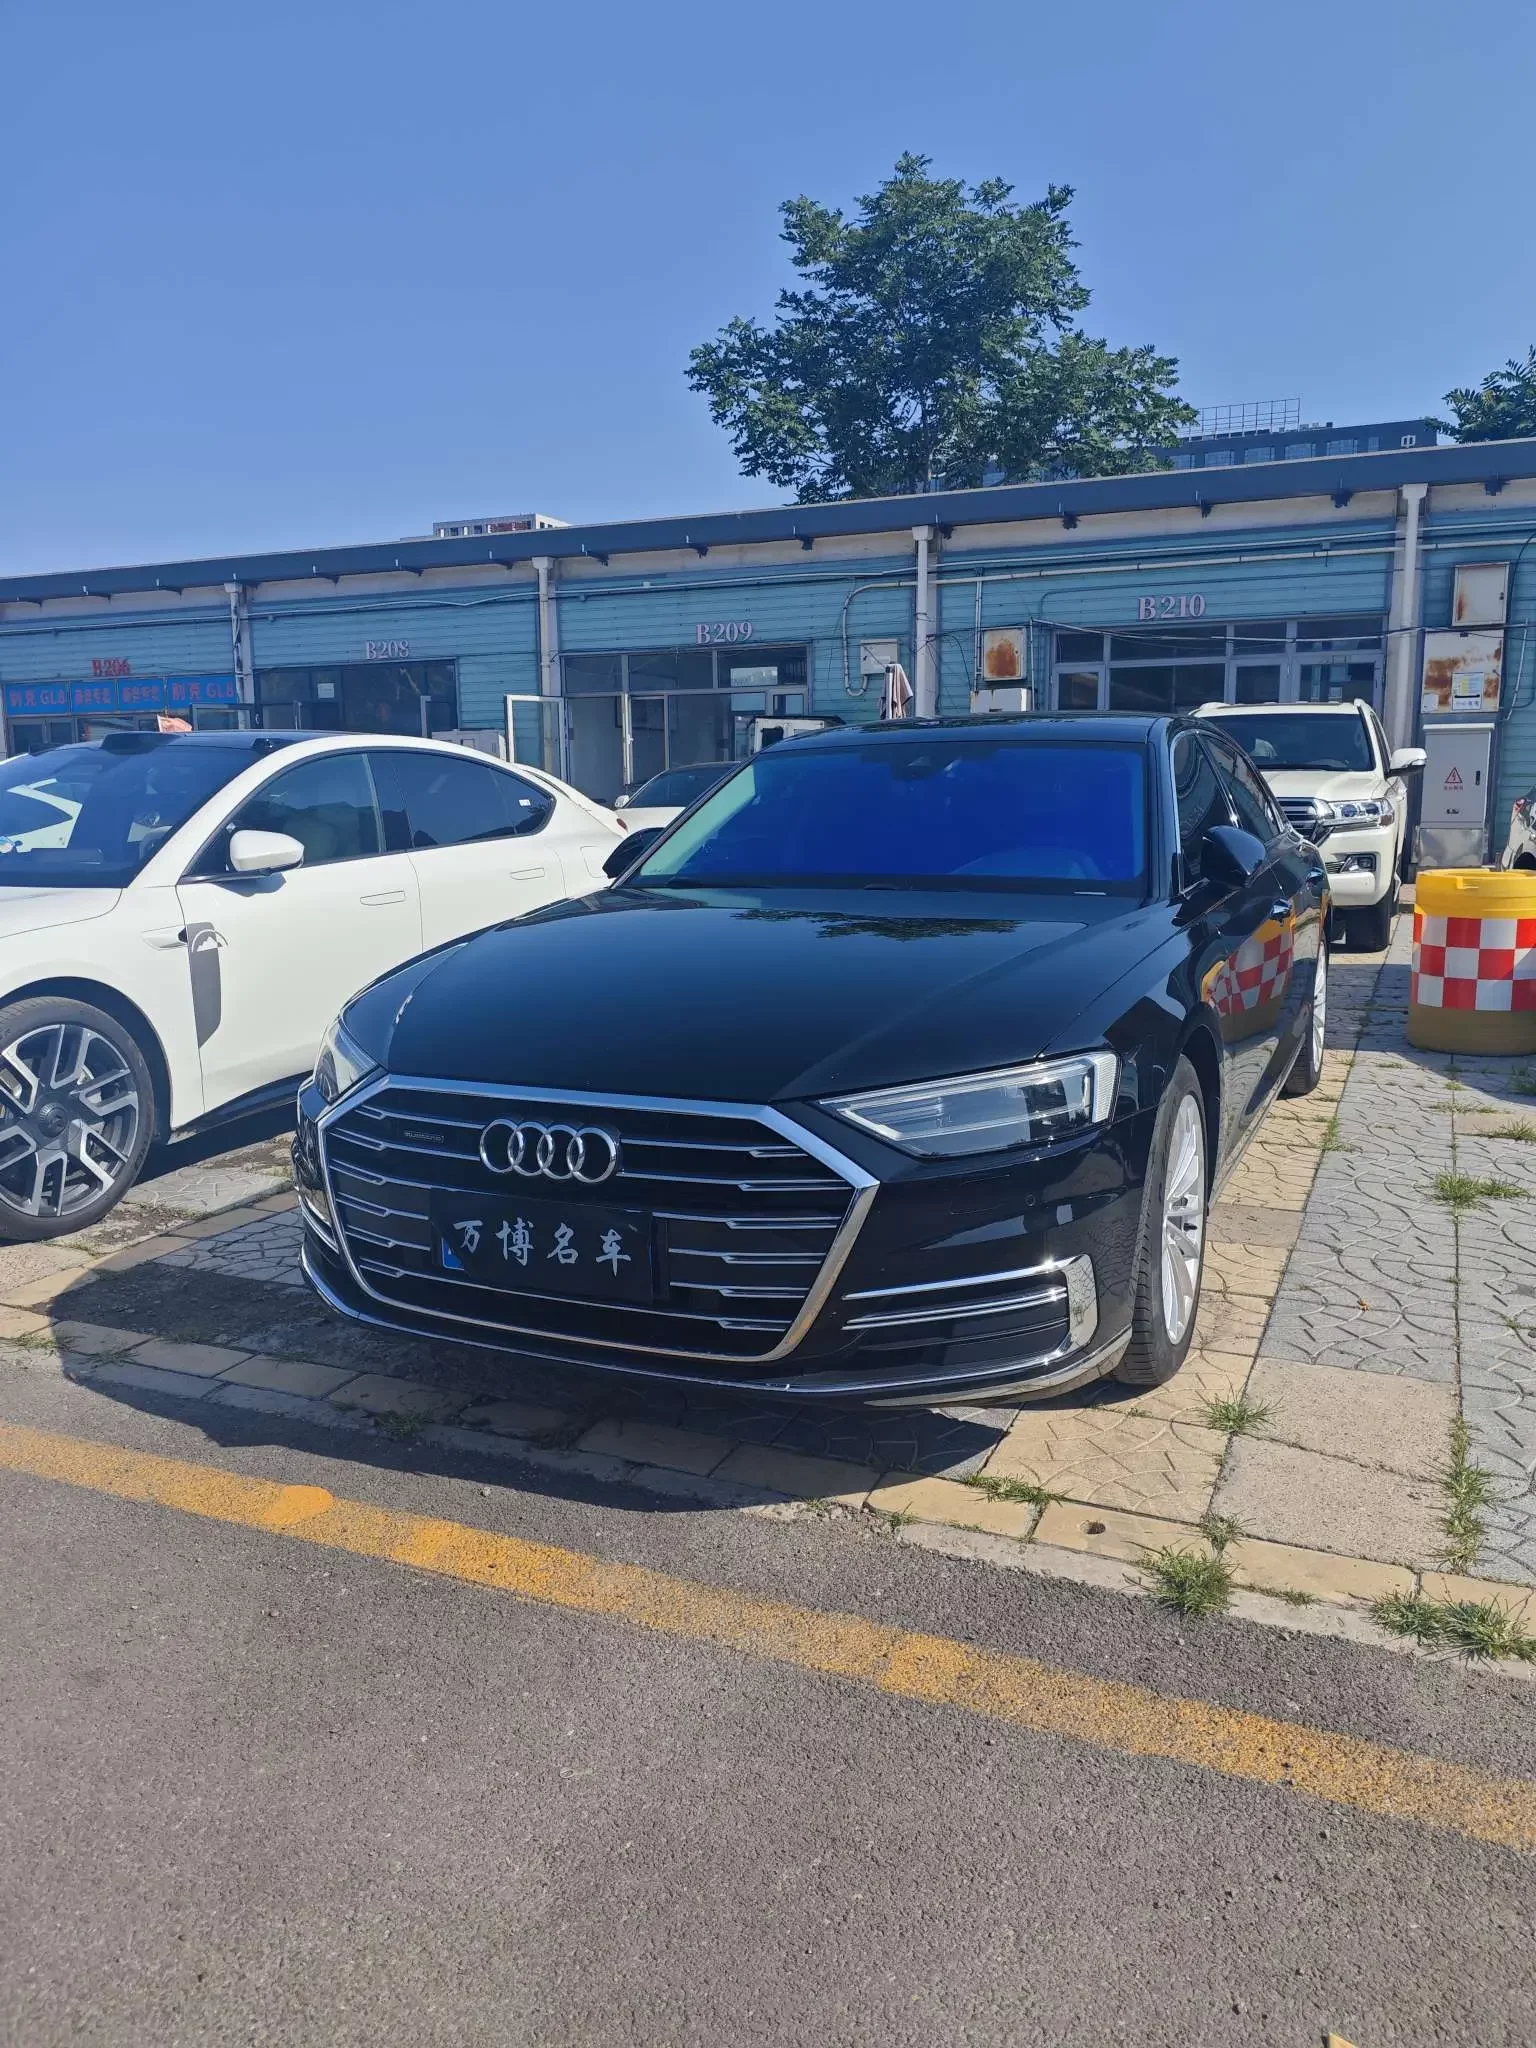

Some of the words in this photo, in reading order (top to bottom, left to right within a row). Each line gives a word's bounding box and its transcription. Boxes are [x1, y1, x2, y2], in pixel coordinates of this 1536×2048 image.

[1137, 593, 1206, 620] B210
[695, 621, 753, 644] B209
[365, 639, 409, 659] B208
[91, 658, 130, 676] B206
[452, 1217, 632, 1277] 万博名车
